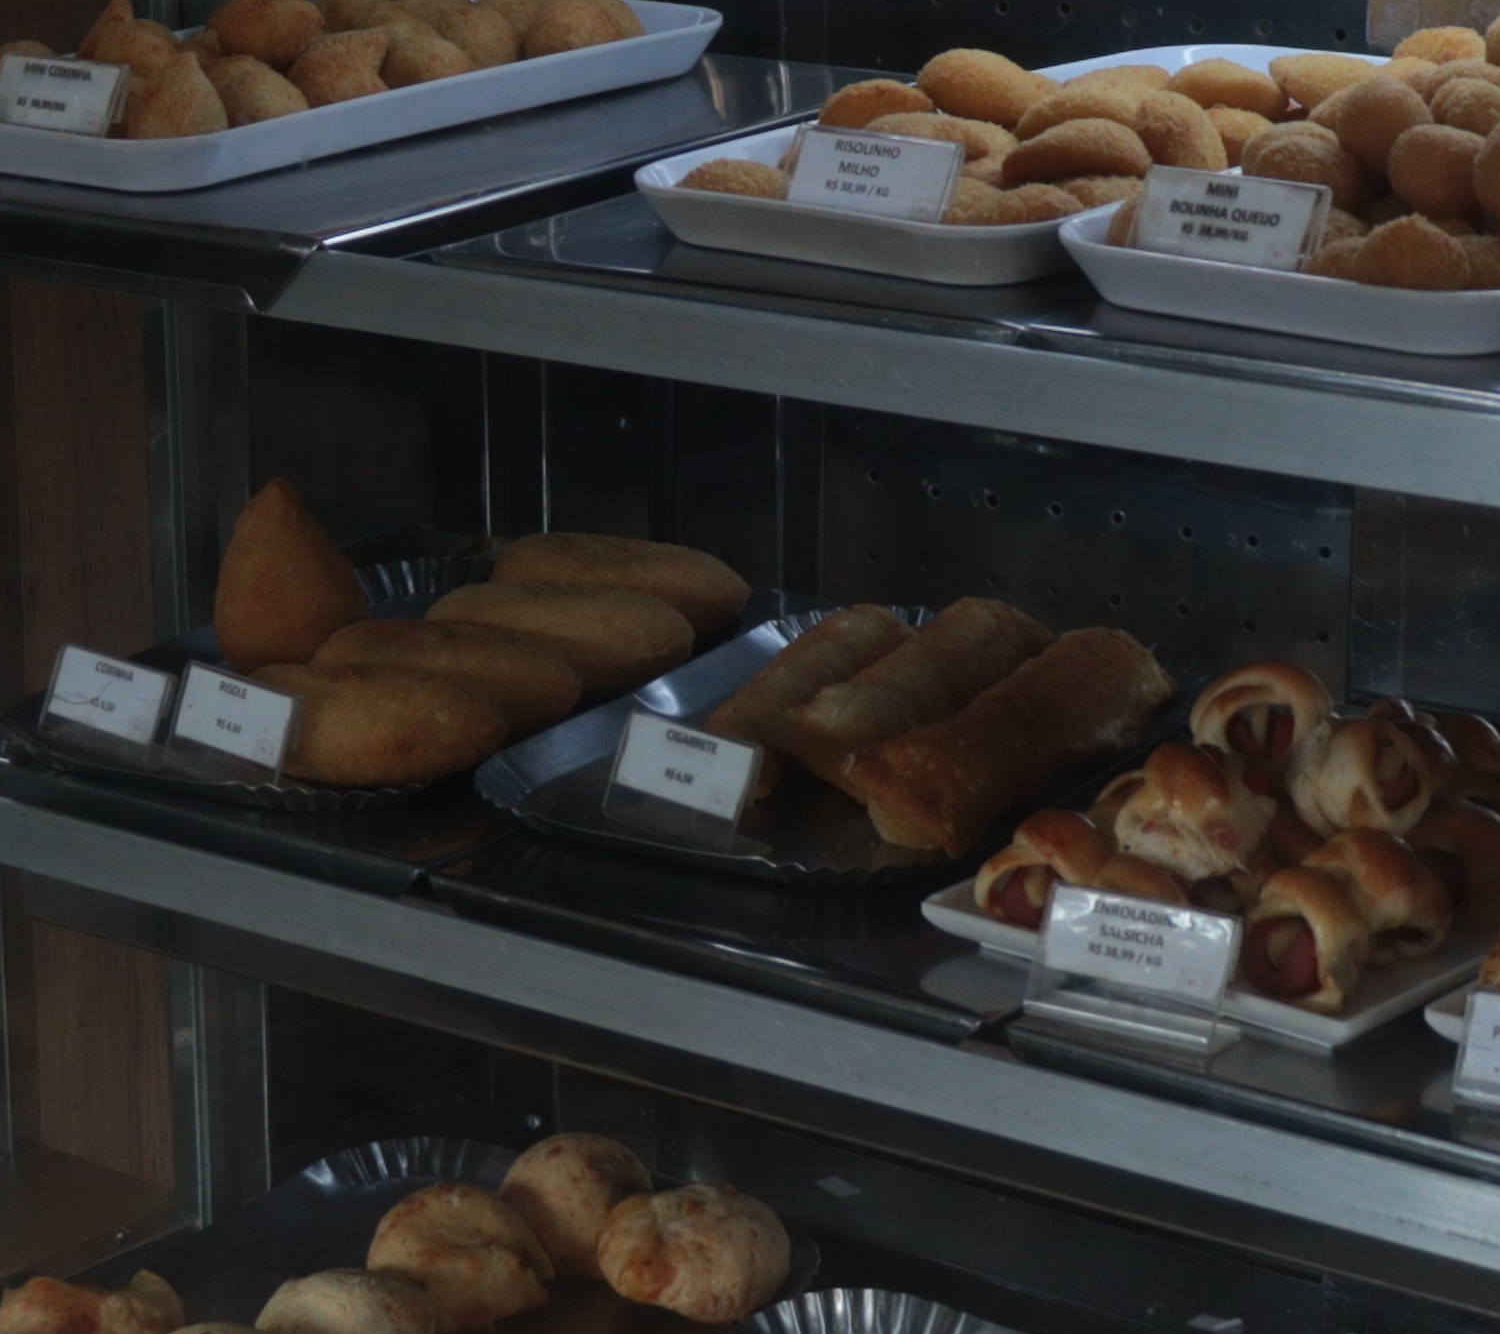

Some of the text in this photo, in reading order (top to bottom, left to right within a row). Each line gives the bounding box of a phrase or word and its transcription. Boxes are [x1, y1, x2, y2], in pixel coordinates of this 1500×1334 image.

[24, 63, 91, 81] MINI COXINHA
[18, 98, 27, 106] R$
[836, 140, 900, 159] RISOLINHO
[839, 162, 879, 178] MILHO
[826, 180, 838, 191] R$
[841, 181, 866, 195] 38,99
[876, 187, 890, 197] KG
[1208, 183, 1239, 199] MINI
[1171, 201, 1280, 227] BOLINHA QUEIJO
[1182, 223, 1194, 234] R$
[96, 662, 134, 682] COXINHA
[220, 682, 247, 700] RISOLE
[217, 718, 225, 729] R$
[667, 729, 719, 755] CIGARRETE
[665, 768, 676, 780] R$
[1101, 925, 1164, 949] SALSICHA
[1089, 943, 1102, 955] R$
[1106, 947, 1134, 962] 38,99
[1147, 955, 1162, 968] KG
